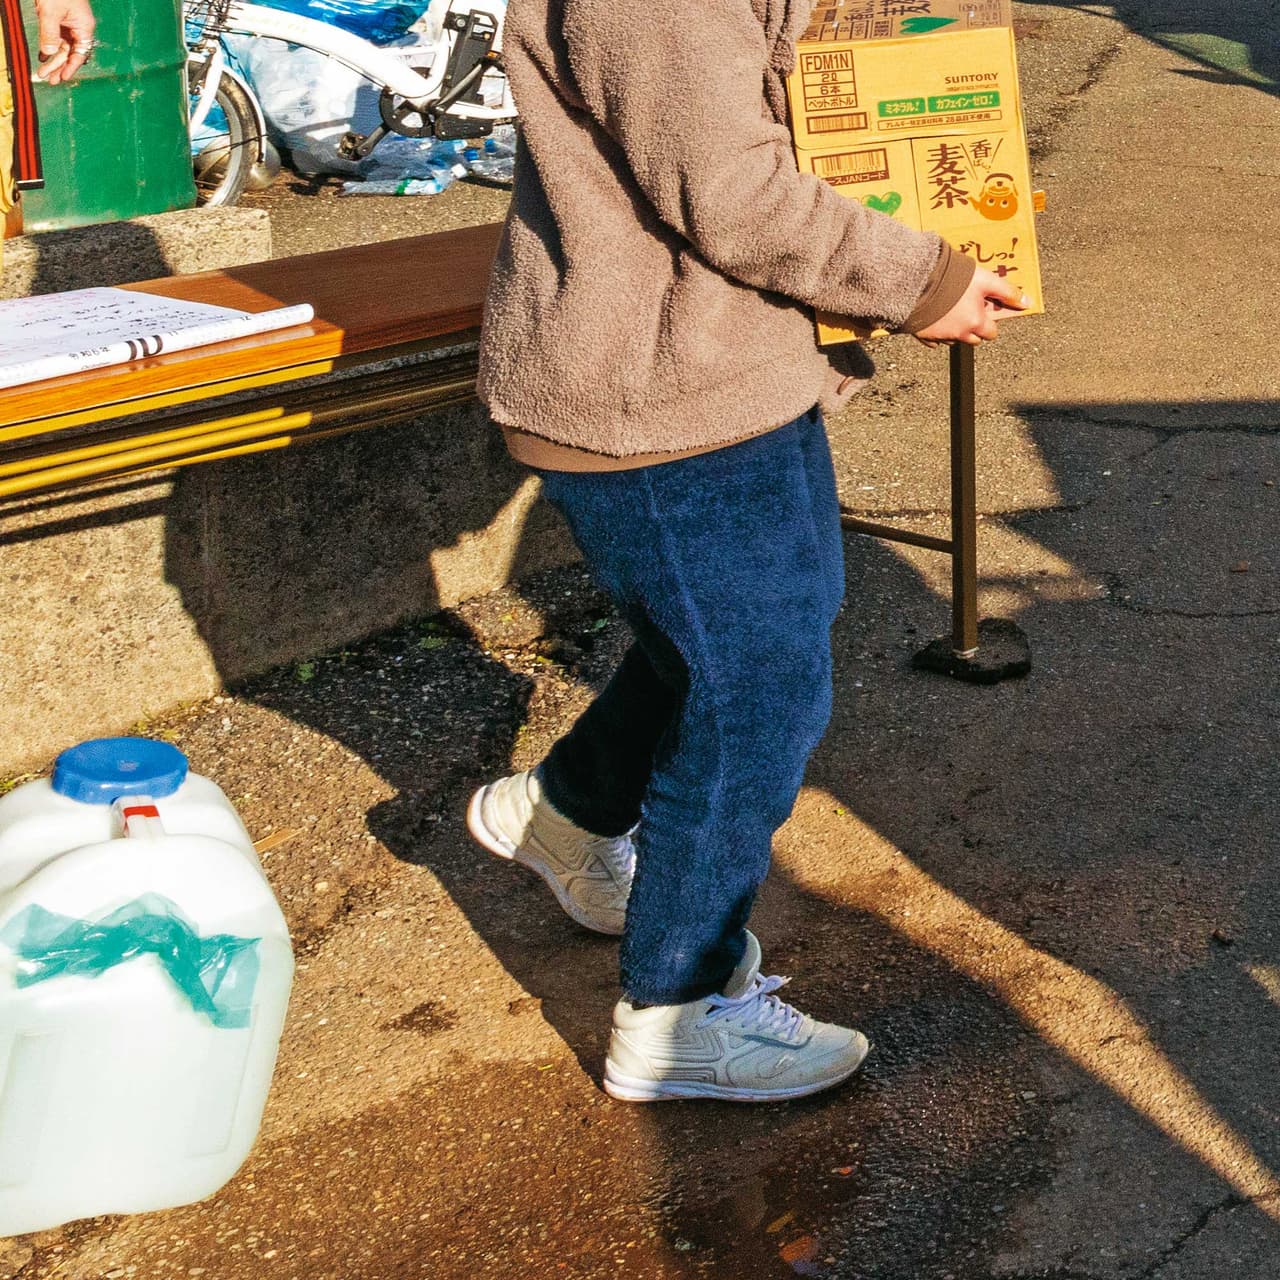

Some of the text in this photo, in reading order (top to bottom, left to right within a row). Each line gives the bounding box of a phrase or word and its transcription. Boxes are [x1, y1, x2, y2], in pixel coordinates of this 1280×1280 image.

[805, 53, 850, 71] FDM1N
[944, 72, 999, 84] SUNTORY
[820, 86, 841, 95] 6本
[808, 96, 855, 108] ペットボトル
[926, 143, 970, 210] 麦茶
